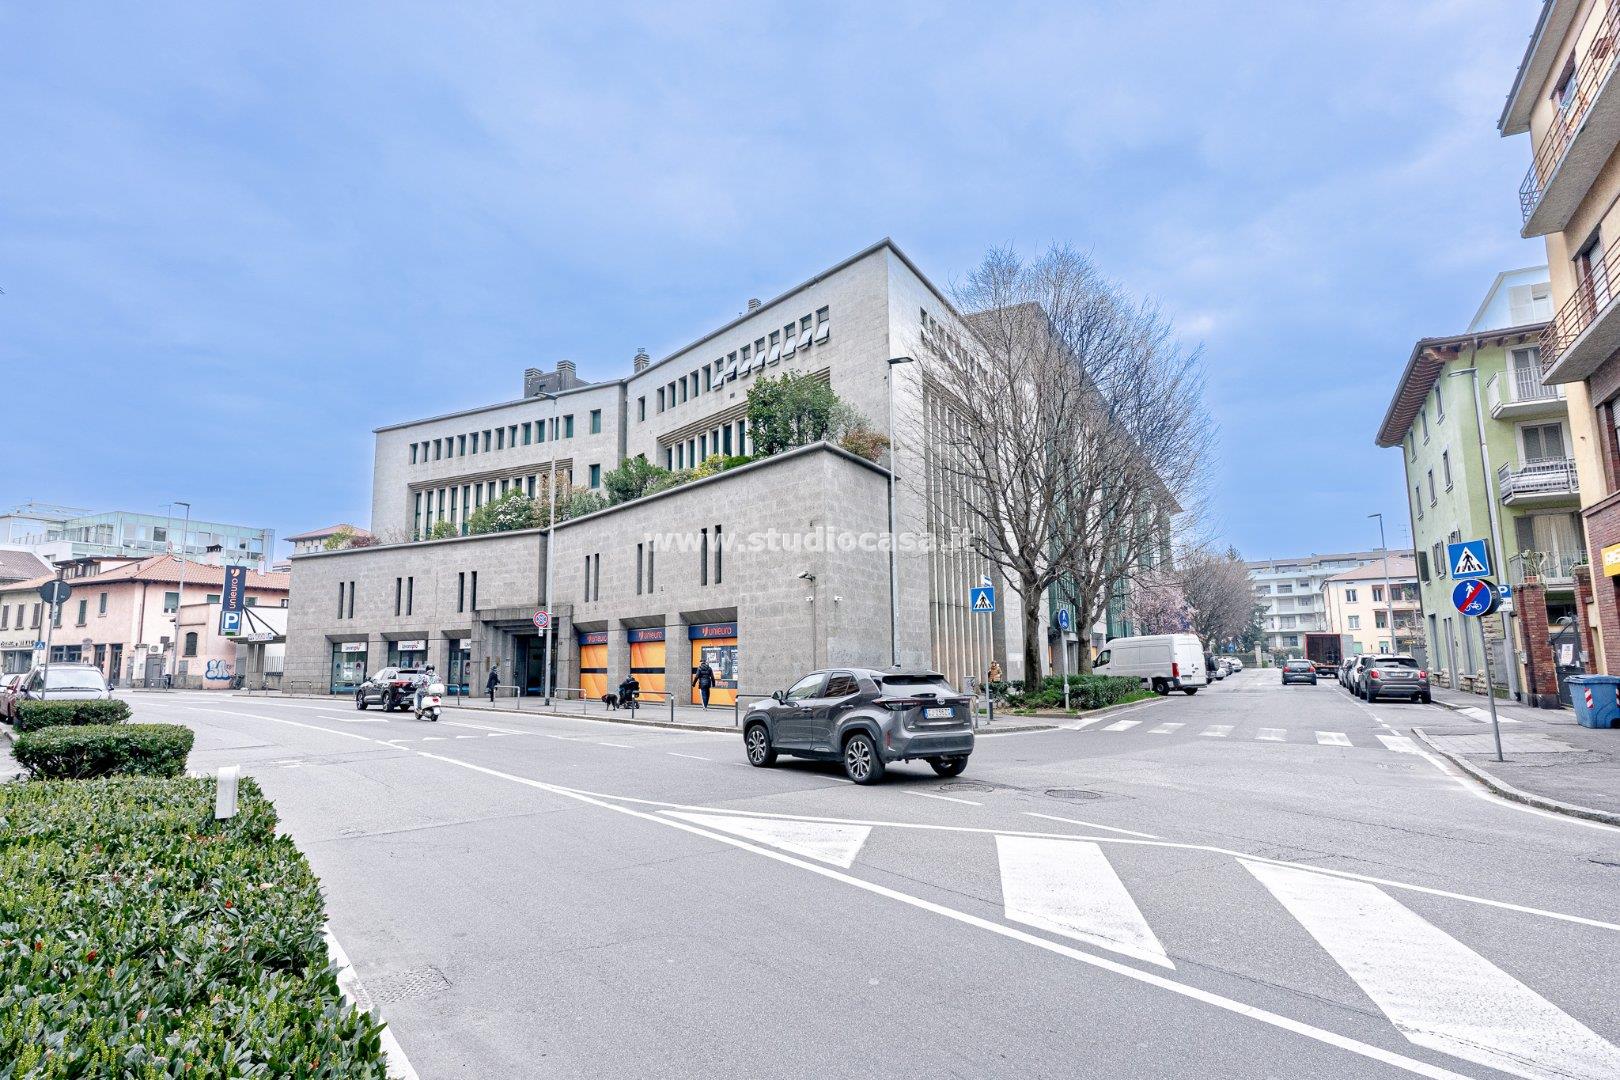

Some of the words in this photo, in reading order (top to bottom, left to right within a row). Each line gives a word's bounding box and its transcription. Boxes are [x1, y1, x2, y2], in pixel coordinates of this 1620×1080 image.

[229, 579, 239, 609] unieuro
[224, 613, 239, 629] P
[643, 631, 663, 640] unieuro
[709, 626, 732, 636] unieuro
